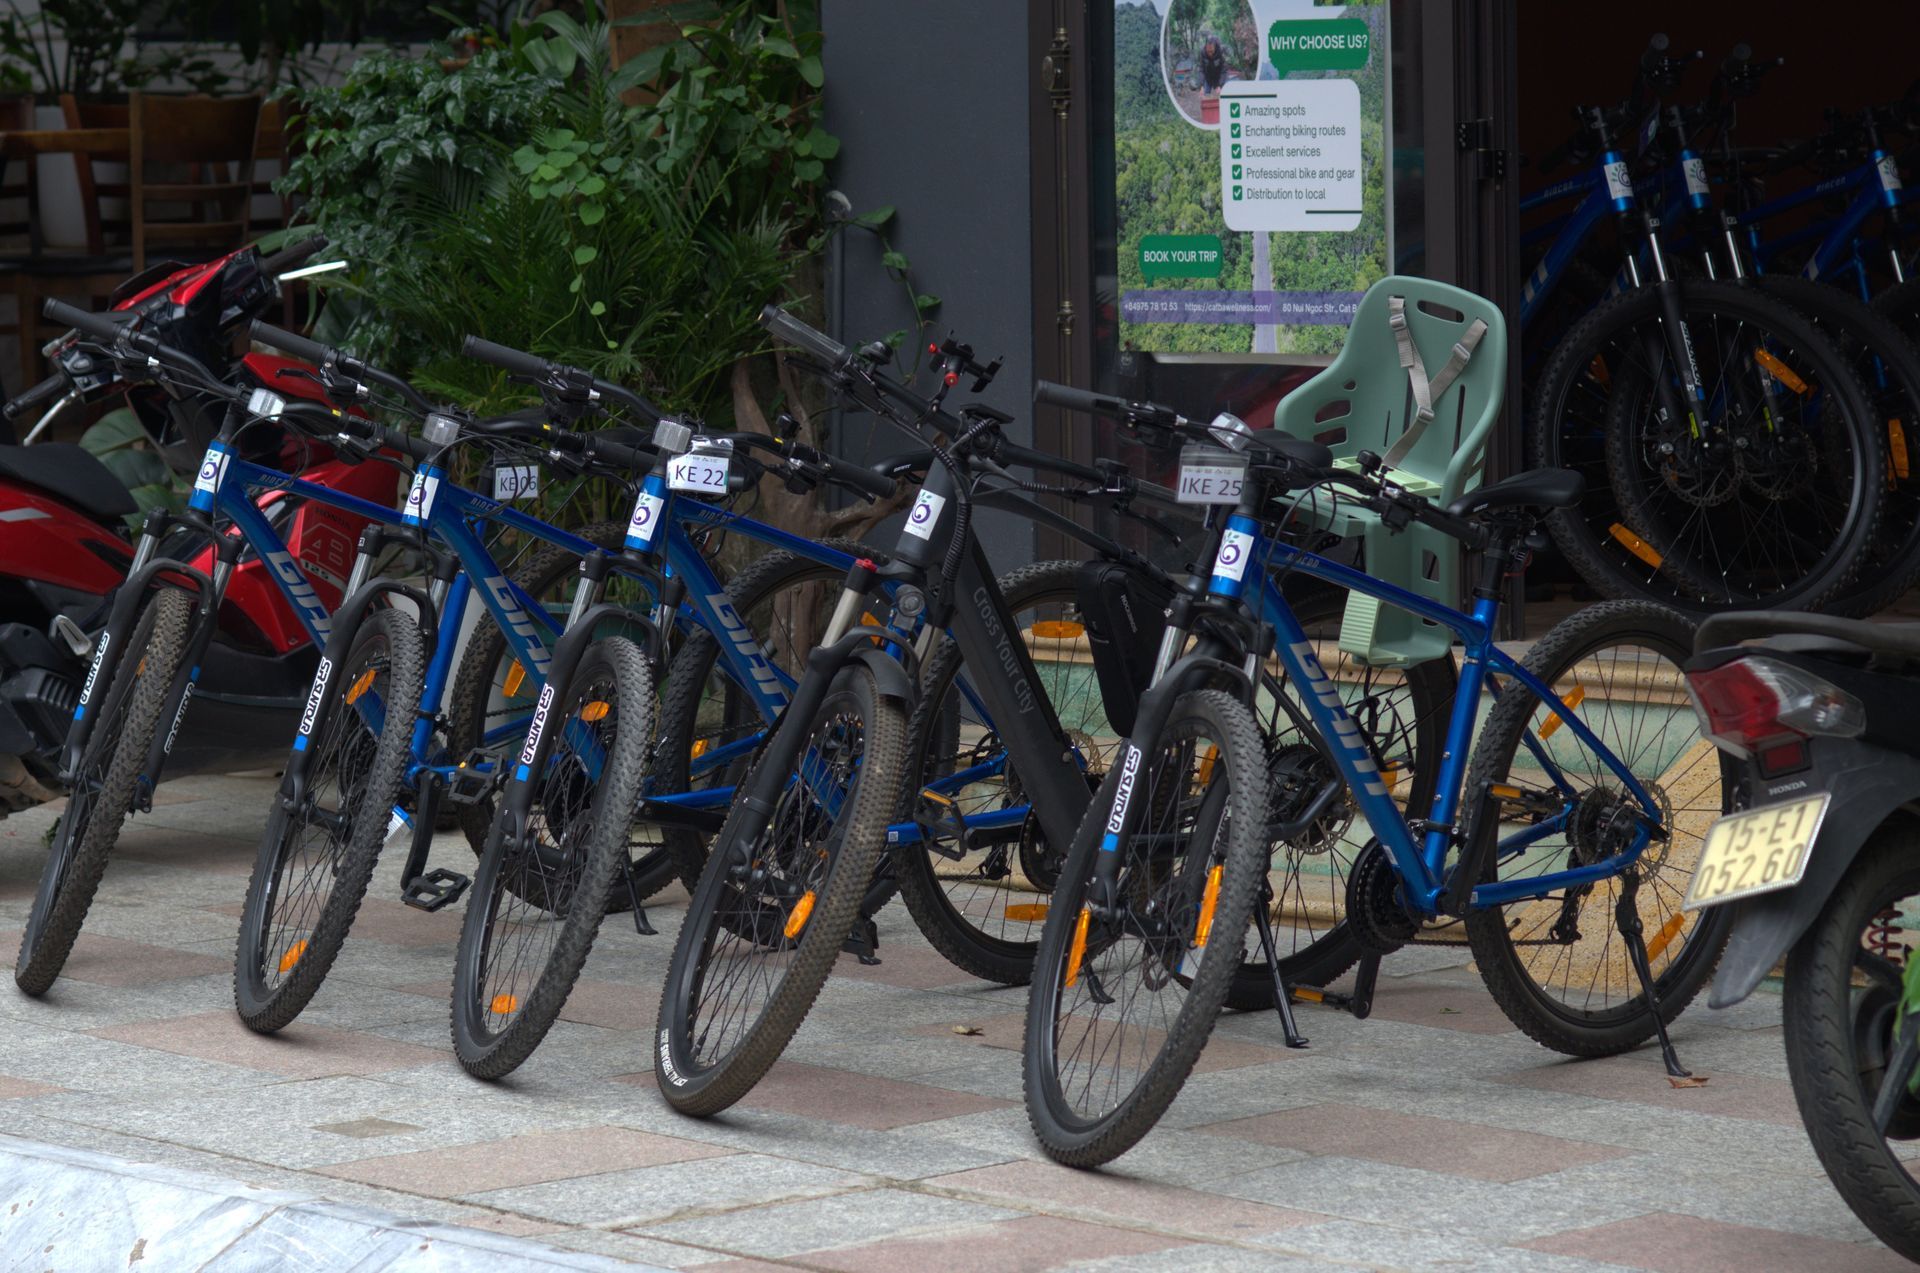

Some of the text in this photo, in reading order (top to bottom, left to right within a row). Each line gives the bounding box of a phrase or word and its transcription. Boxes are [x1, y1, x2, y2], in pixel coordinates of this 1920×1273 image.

[1270, 34, 1368, 50] WHY CHOOSE US?
[1245, 105, 1306, 118] Amazing spots
[1245, 125, 1346, 139] Enchanting biking routes
[1246, 145, 1321, 158] Excellent services
[1246, 167, 1356, 181] Professional bike and gear
[1247, 187, 1326, 200] Distribution to local
[1143, 250, 1218, 263] BOOK YOUR TRIP
[1150, 302, 1159, 311] 78
[1160, 302, 1169, 311] 12
[1339, 303, 1351, 313] Cat
[500, 475, 537, 492] KE 06
[675, 464, 724, 487] KE 22
[1182, 477, 1242, 497] IKE 25
[304, 561, 329, 580] 125
[265, 551, 333, 643] GIA
[484, 575, 552, 674] GIA
[973, 586, 1035, 715] Cross Your City
[300, 680, 325, 735] SUNTOUR
[521, 707, 547, 764] SUNTOUR
[1768, 780, 1807, 796] HONDA
[1108, 771, 1135, 833] SUNTOUR
[1723, 804, 1808, 857] 15-E1
[1693, 843, 1805, 900] 052.60
